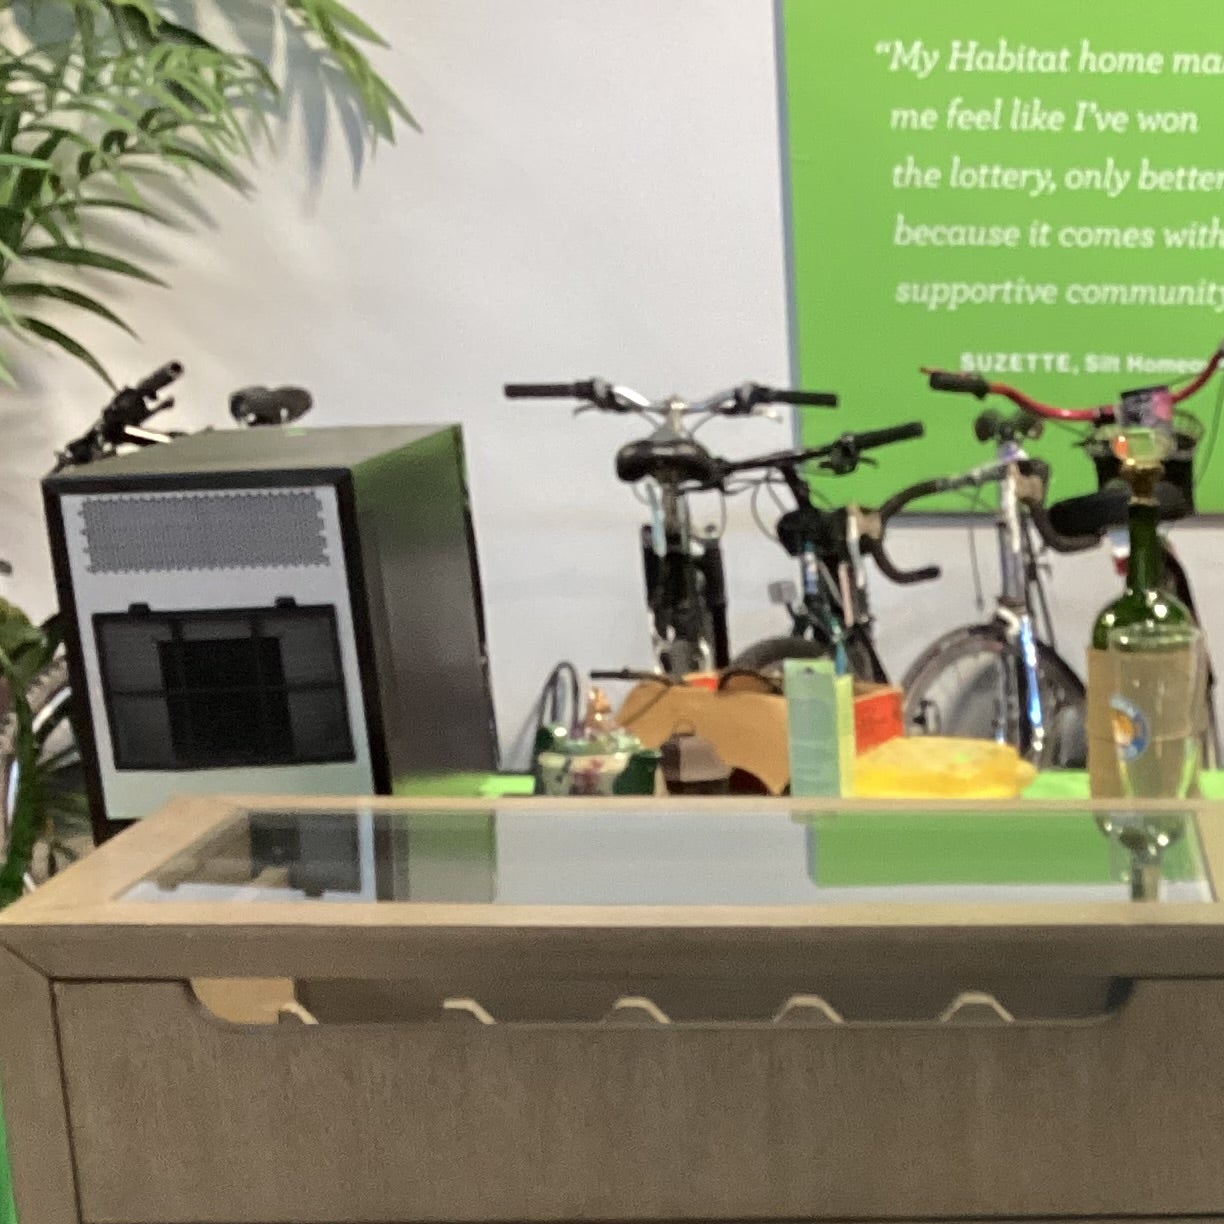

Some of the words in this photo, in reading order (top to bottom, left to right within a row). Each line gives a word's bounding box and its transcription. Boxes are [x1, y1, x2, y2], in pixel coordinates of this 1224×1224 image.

[947, 38, 1071, 74] Habitat
[1078, 38, 1164, 74] home
[890, 107, 938, 130] me
[946, 97, 1003, 131] feel
[1010, 98, 1065, 131] like
[1136, 110, 1200, 134] won
[892, 156, 942, 189] the
[950, 156, 1057, 197] lottery,
[1064, 158, 1132, 197] only
[894, 214, 1021, 247] because
[1029, 219, 1053, 247] it
[1058, 226, 1155, 249] comes
[896, 277, 1059, 311] supportive
[959, 352, 1080, 375] SUZETTE,
[1085, 353, 1121, 374] Silt
